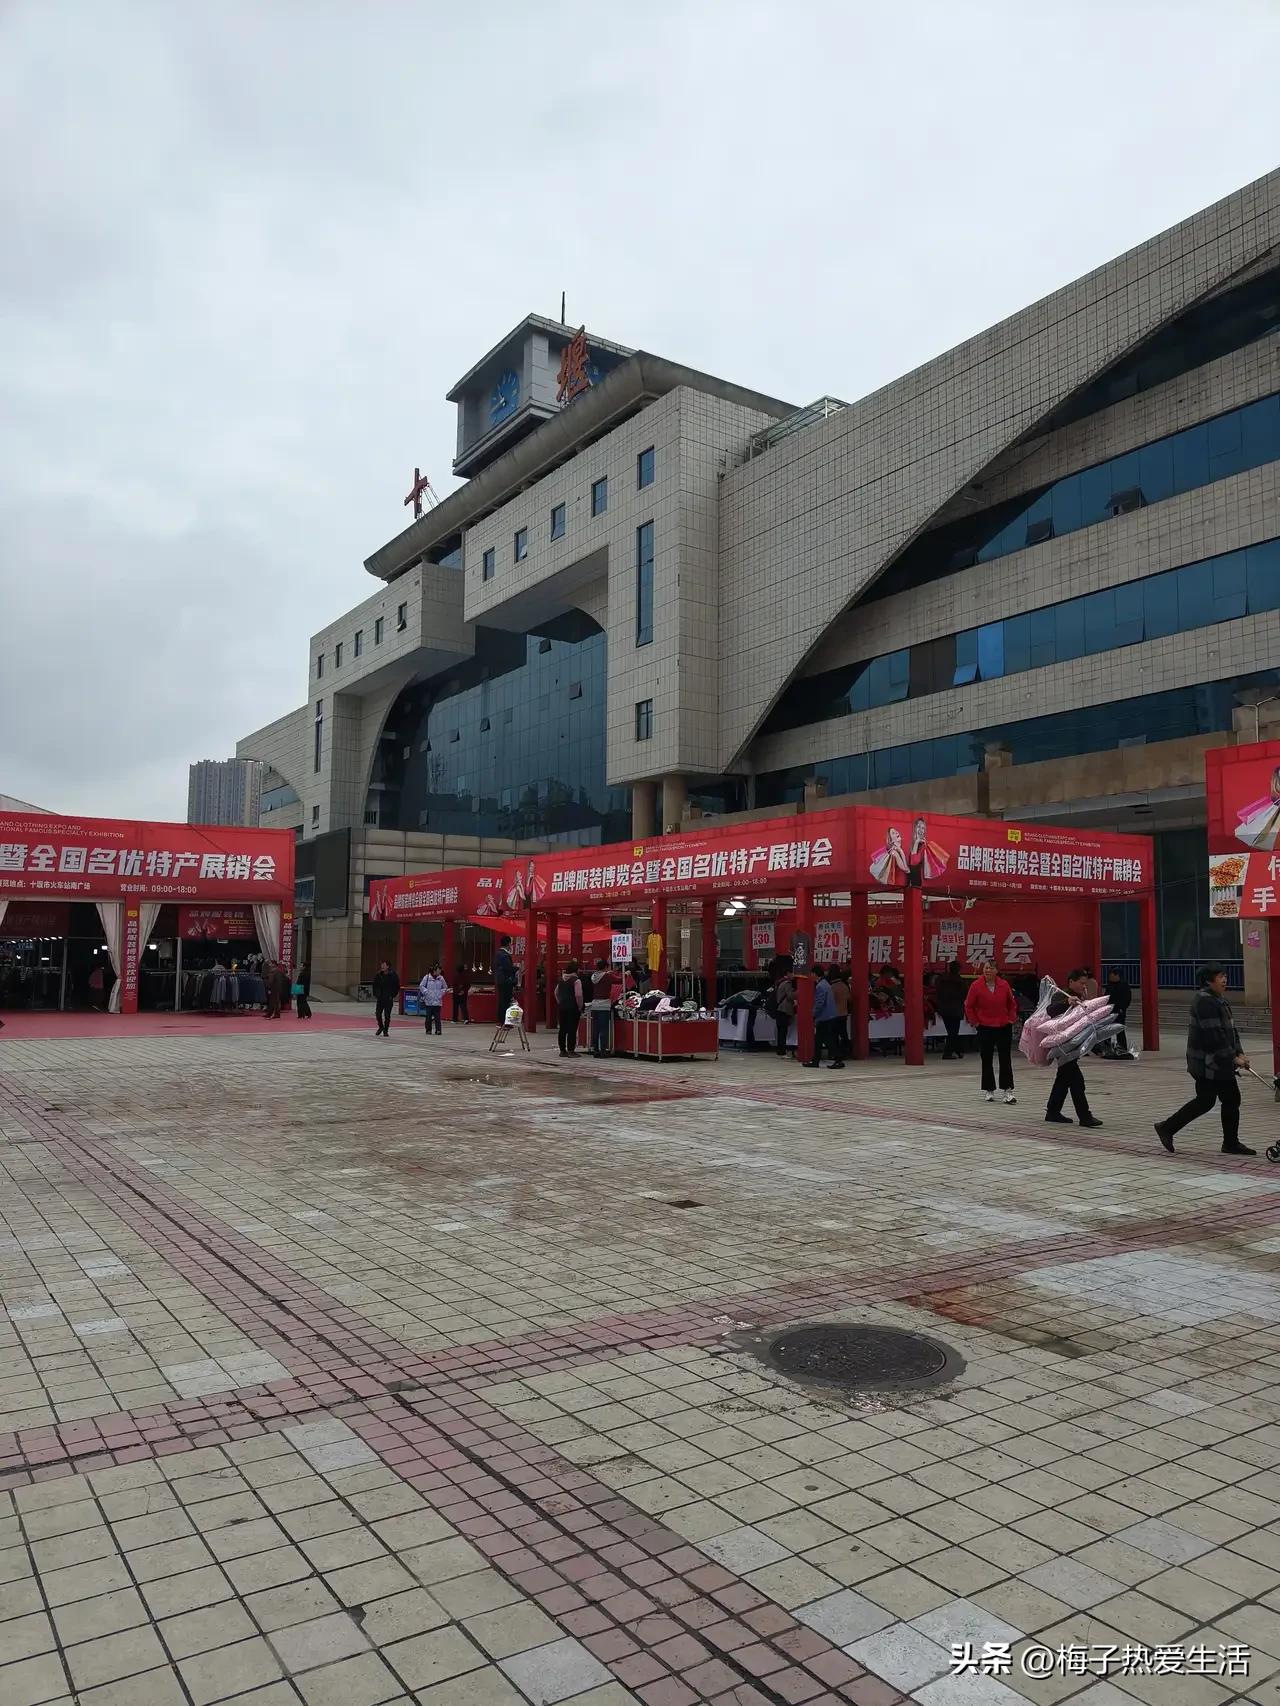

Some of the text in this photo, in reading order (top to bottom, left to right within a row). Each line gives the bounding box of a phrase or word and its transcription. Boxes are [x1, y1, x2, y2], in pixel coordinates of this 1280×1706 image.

[53, 829, 88, 837] SPECIALTY
[0, 843, 276, 881] 暨全国名优特产展销会
[551, 837, 832, 893] 品牌服装博览会暨全国名优特产展销会
[957, 845, 1142, 883] 品牌服装博览会暨全国名优特产展销会
[757, 933, 770, 945] 30
[823, 933, 840, 948] 20
[616, 945, 627, 957] 20
